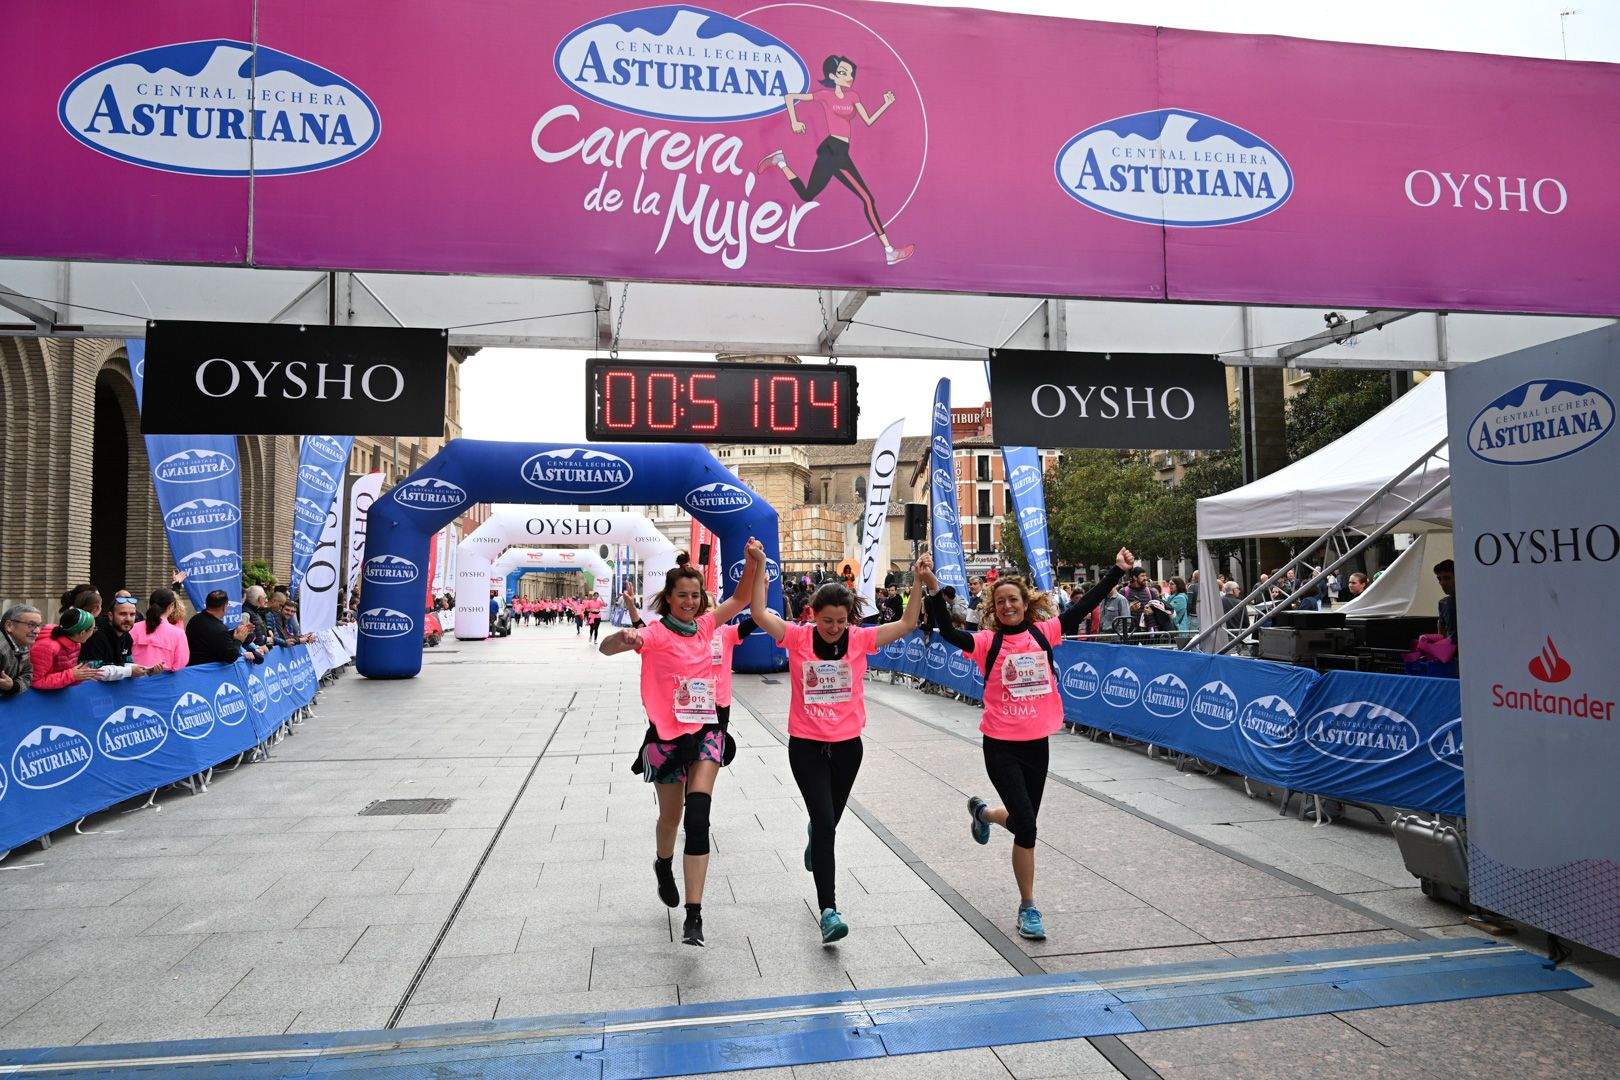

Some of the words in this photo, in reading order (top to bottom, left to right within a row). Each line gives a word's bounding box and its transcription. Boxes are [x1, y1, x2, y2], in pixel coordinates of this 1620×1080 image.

[616, 40, 695, 56] CENTRAL
[704, 48, 783, 64] LECHERA
[575, 40, 790, 98] ASTURIANA
[137, 83, 237, 100] CENTRAL
[248, 88, 347, 106] LECHERA
[84, 83, 357, 146] ASTURIANA
[531, 104, 744, 176] Carrera
[1111, 146, 1184, 161] CENTRAL
[1194, 151, 1268, 166] LECHERA
[1074, 147, 1277, 199] ASTURIANA
[1404, 169, 1568, 215] OYSHO
[584, 171, 624, 215] de
[632, 170, 661, 216] la
[655, 171, 820, 270] Mujer
[195, 358, 405, 402] OYSHO
[1031, 383, 1196, 421] OYSHO
[1495, 408, 1539, 425] CENTRAL
[1544, 398, 1596, 414] LECHERA
[951, 413, 980, 424] TIBUR
[1477, 409, 1603, 451] ASTURIANA
[530, 461, 625, 482] ASTURIANA
[398, 488, 461, 503] ASTURIANA
[691, 494, 749, 507] ASTURIANA
[525, 518, 613, 536] OYSHO
[863, 450, 896, 583] OYSHO
[472, 535, 502, 543] OYSHO
[1474, 524, 1620, 566] OYSHO
[365, 565, 415, 578] ASTURIANA
[459, 570, 486, 578] OYSHO
[458, 605, 485, 613] OYSHO
[360, 617, 409, 631] ASTURIANA
[1018, 669, 1034, 677] 016
[1064, 673, 1096, 691] ASTURIANA
[1102, 680, 1137, 699] ASTURIANA
[1144, 687, 1185, 709] ASTURIANA
[1002, 704, 1037, 716] SUMA
[1491, 684, 1615, 721] Santander
[177, 710, 213, 732] ASTURIANA
[104, 723, 165, 753] ASTURIANA
[1310, 720, 1408, 751] ASTURIANA
[20, 745, 89, 781] ASTURIANA
